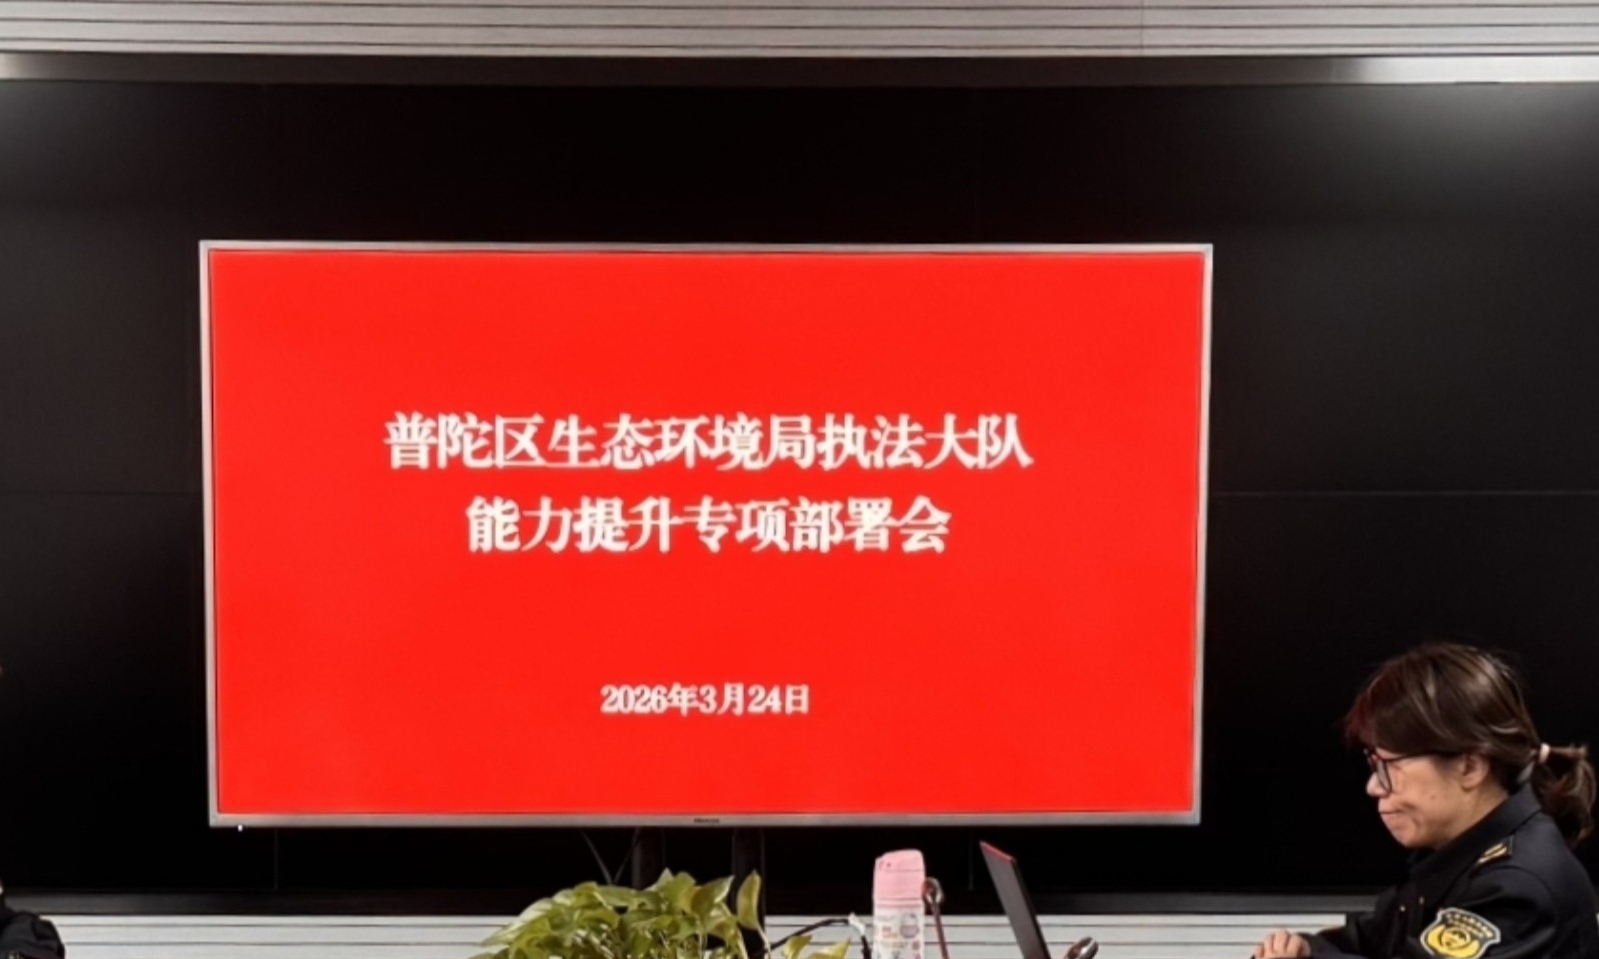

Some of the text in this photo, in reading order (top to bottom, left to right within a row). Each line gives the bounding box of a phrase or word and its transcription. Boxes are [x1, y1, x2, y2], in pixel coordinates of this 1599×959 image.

[384, 411, 1034, 471] 普陀区生态环境局执法大队
[465, 495, 952, 554] 能力提升专项部署会
[600, 682, 810, 716] 2026年3月24日
